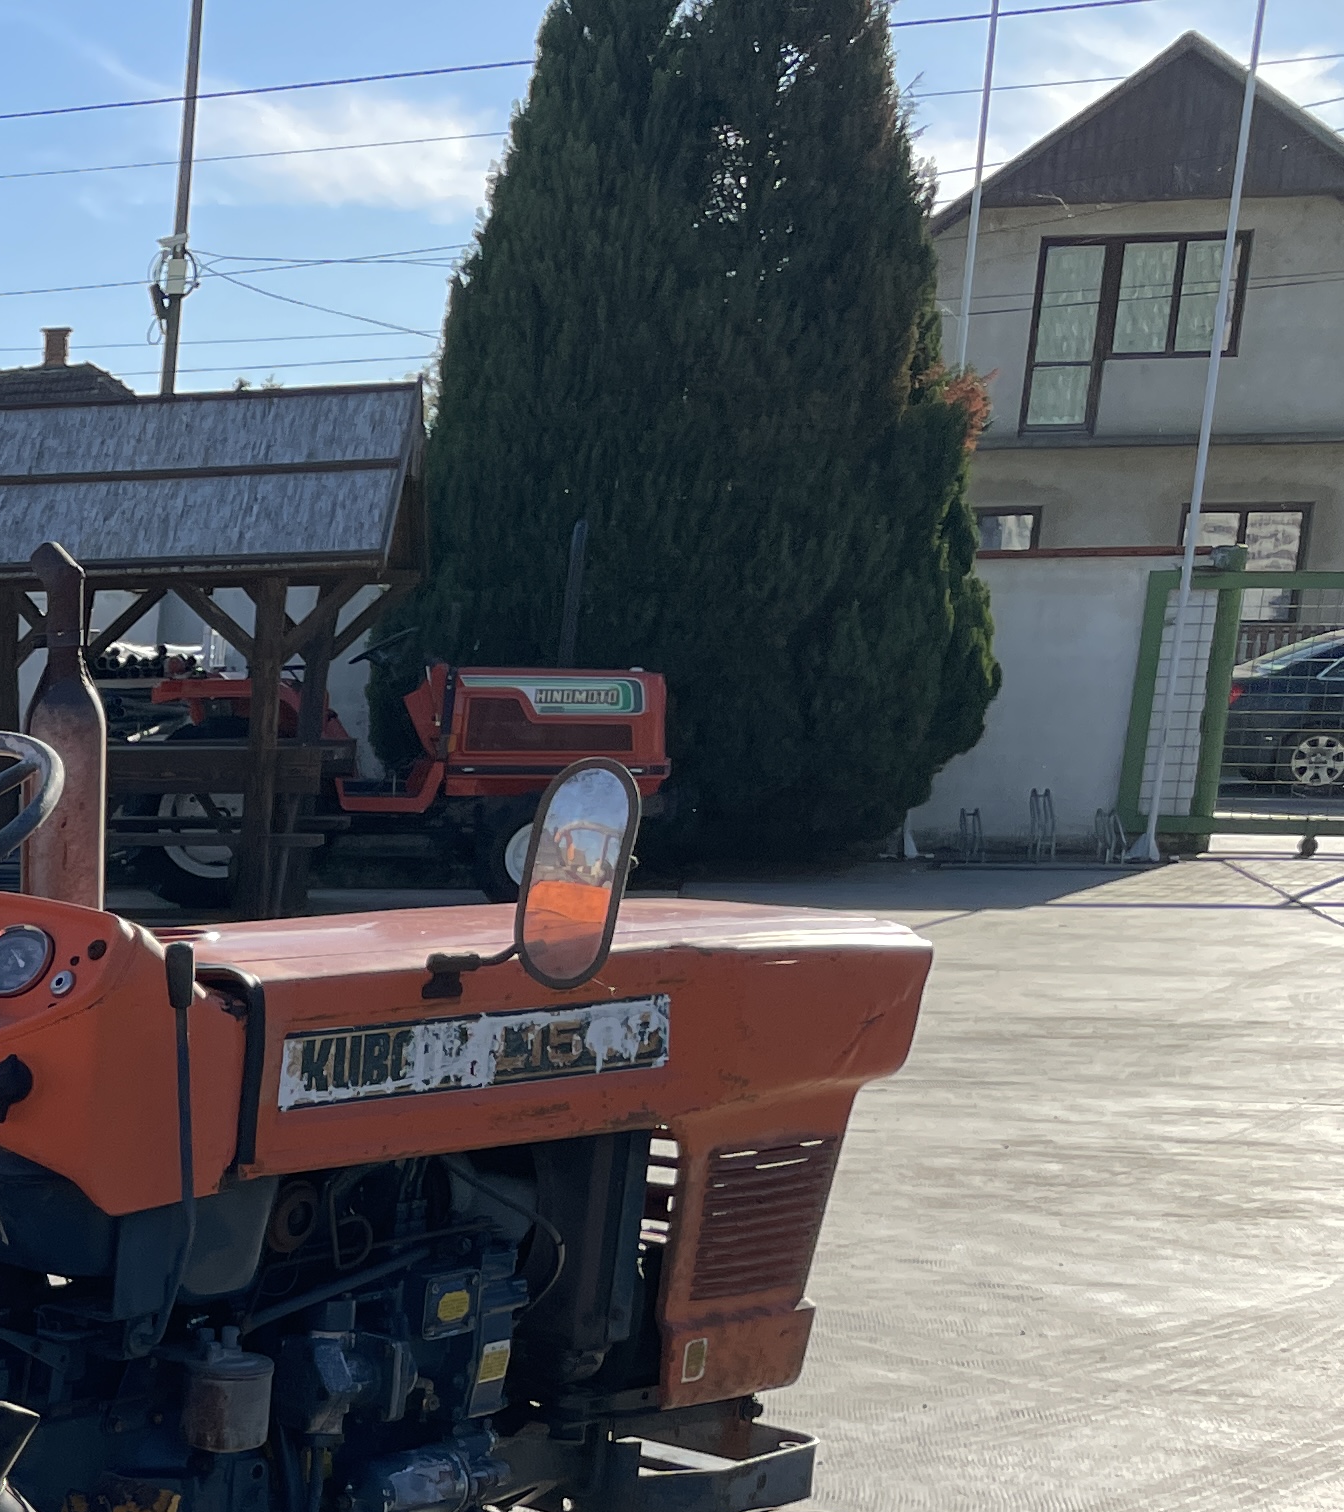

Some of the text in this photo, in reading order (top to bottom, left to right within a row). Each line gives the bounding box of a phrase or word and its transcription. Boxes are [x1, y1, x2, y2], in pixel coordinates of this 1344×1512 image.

[535, 689, 618, 703] HINOMOTO
[301, 1004, 662, 1092] KUBO L15
